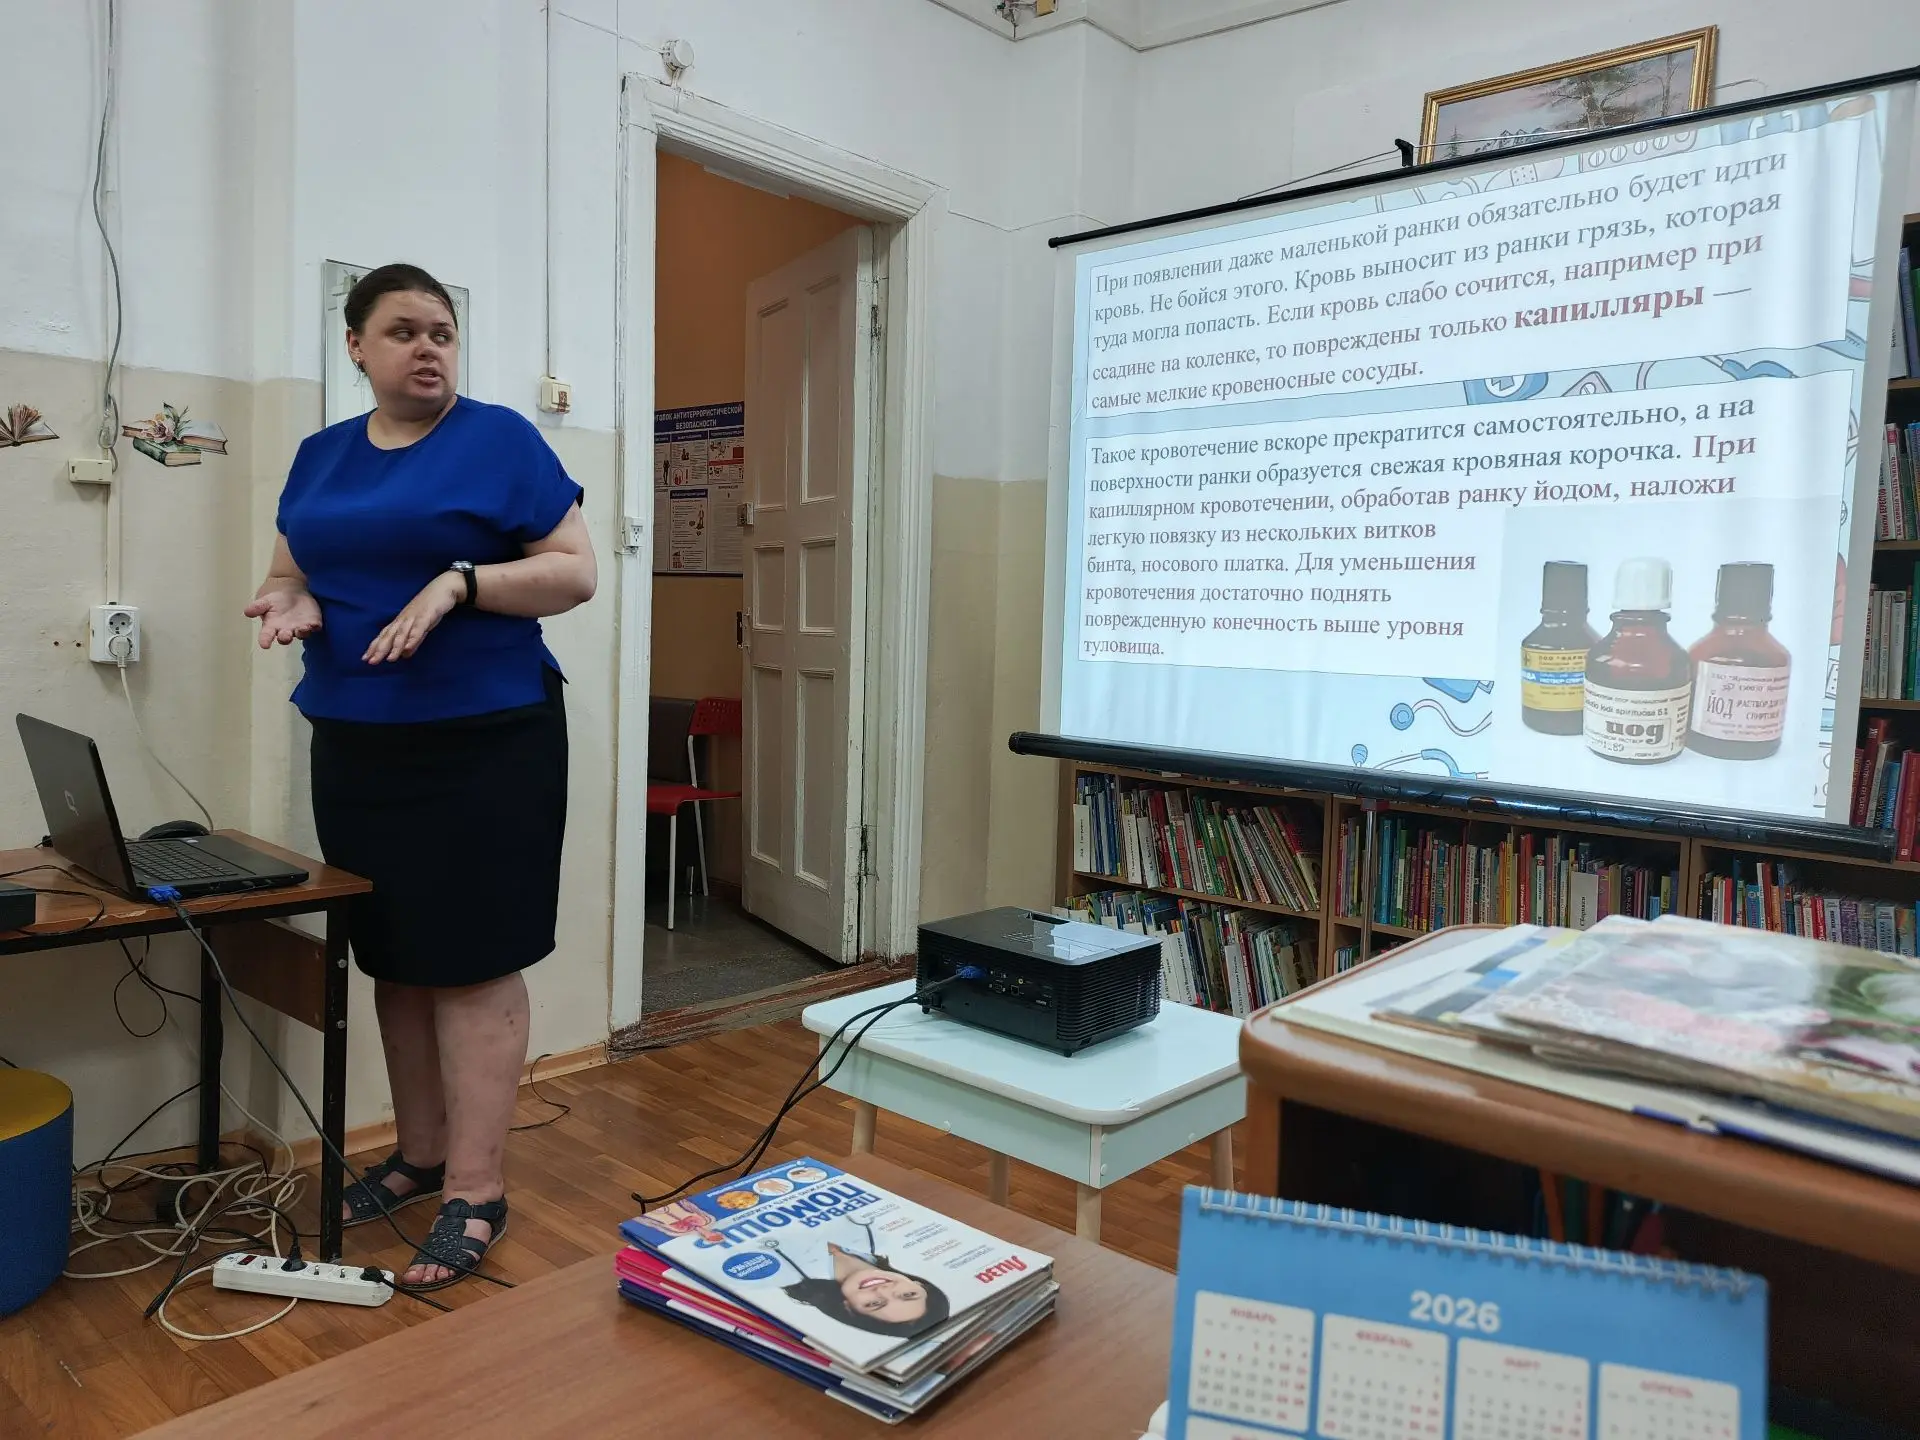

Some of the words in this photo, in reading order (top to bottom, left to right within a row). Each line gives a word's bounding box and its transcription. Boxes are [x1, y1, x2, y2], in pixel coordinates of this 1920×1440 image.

[1096, 274, 1129, 296] При
[1133, 259, 1223, 286] появлении
[1227, 250, 1274, 273] даже
[1280, 223, 1389, 261] маленькой
[1394, 215, 1460, 247] ранки
[1467, 186, 1619, 227] обязательно
[1629, 168, 1706, 203] будет
[1715, 153, 1787, 185] идти
[1095, 303, 1144, 325] кровь.
[1150, 293, 1173, 313] Не
[1177, 286, 1227, 308] бойся
[1233, 279, 1288, 300] этого.
[1295, 267, 1356, 294] Кровь
[1362, 250, 1457, 279] выносит
[1464, 245, 1489, 263] из
[1495, 230, 1570, 264] ранки
[1577, 219, 1655, 249] грязь,
[1666, 193, 1781, 229] которая
[1093, 332, 1128, 353] туда
[1132, 324, 1180, 343] могла
[1185, 314, 1260, 336] попасть.
[1266, 304, 1315, 325] Если
[1320, 295, 1379, 321] кровь
[1385, 280, 1448, 308] слабо
[1455, 269, 1555, 297] сочится,
[1564, 246, 1697, 282] например
[1707, 235, 1763, 266] при
[1092, 361, 1156, 381] ссадине
[1161, 358, 1181, 373] на
[1185, 348, 1260, 370] коленке,
[1265, 344, 1287, 360] то
[1292, 327, 1421, 358] повреждены
[1428, 316, 1508, 340] только
[1514, 286, 1705, 329] капилляры
[1091, 391, 1141, 409] самые
[1146, 385, 1208, 404] мелкие
[1211, 370, 1336, 397] кровеносные
[1341, 361, 1424, 385] сосуды.
[673, 404, 743, 420] АНТИТЕРРОРИСТИЧЕСКОЙ
[675, 419, 717, 430] БЕЗОПАСНОСТИ
[1091, 447, 1136, 464] Такое
[1140, 440, 1259, 466] кровотечение
[1263, 433, 1328, 455] вскоре
[1333, 423, 1466, 452] прекратится
[1473, 406, 1687, 437] самостоятельно,
[1695, 404, 1711, 421] а
[1717, 399, 1756, 419] на
[1090, 474, 1194, 494] поверхности
[1198, 470, 1252, 492] ранки
[1256, 462, 1363, 487] образуется
[1370, 458, 1446, 477] свежая
[1451, 450, 1562, 477] кровяная
[1569, 443, 1681, 470] корочка.
[1692, 434, 1757, 464] При
[1089, 502, 1196, 521] капиллярном
[1200, 495, 1335, 519] кровотечении,
[1340, 486, 1450, 513] обработав
[1456, 486, 1528, 510] ранку
[1533, 480, 1620, 503] йодом,
[1629, 476, 1737, 497] наложи
[1087, 532, 1146, 549] легкую
[1149, 530, 1217, 548] повязку
[1221, 529, 1241, 543] из
[1245, 526, 1357, 542] нескольких
[1363, 523, 1436, 539] витков
[1087, 556, 1136, 576] бинта,
[1141, 559, 1218, 573] носового
[1223, 558, 1289, 572] платка.
[1294, 551, 1334, 576] Для
[1339, 556, 1476, 577] уменьшения
[1086, 587, 1196, 605] кровотечения
[1199, 587, 1304, 603] достаточно
[1310, 587, 1392, 605] поднять
[1085, 614, 1206, 634] поврежденную
[1212, 617, 1318, 632] конечность
[1323, 619, 1381, 634] выше
[1386, 620, 1464, 640] уровня
[1084, 641, 1164, 656] туловища.
[1706, 689, 1733, 720] ЙОД
[693, 1181, 867, 1249] ПОМОЩЬ
[800, 1192, 882, 1228] ПЕРВАЯ
[974, 1255, 1028, 1284] Лиза
[1409, 1290, 1501, 1334] 2026
